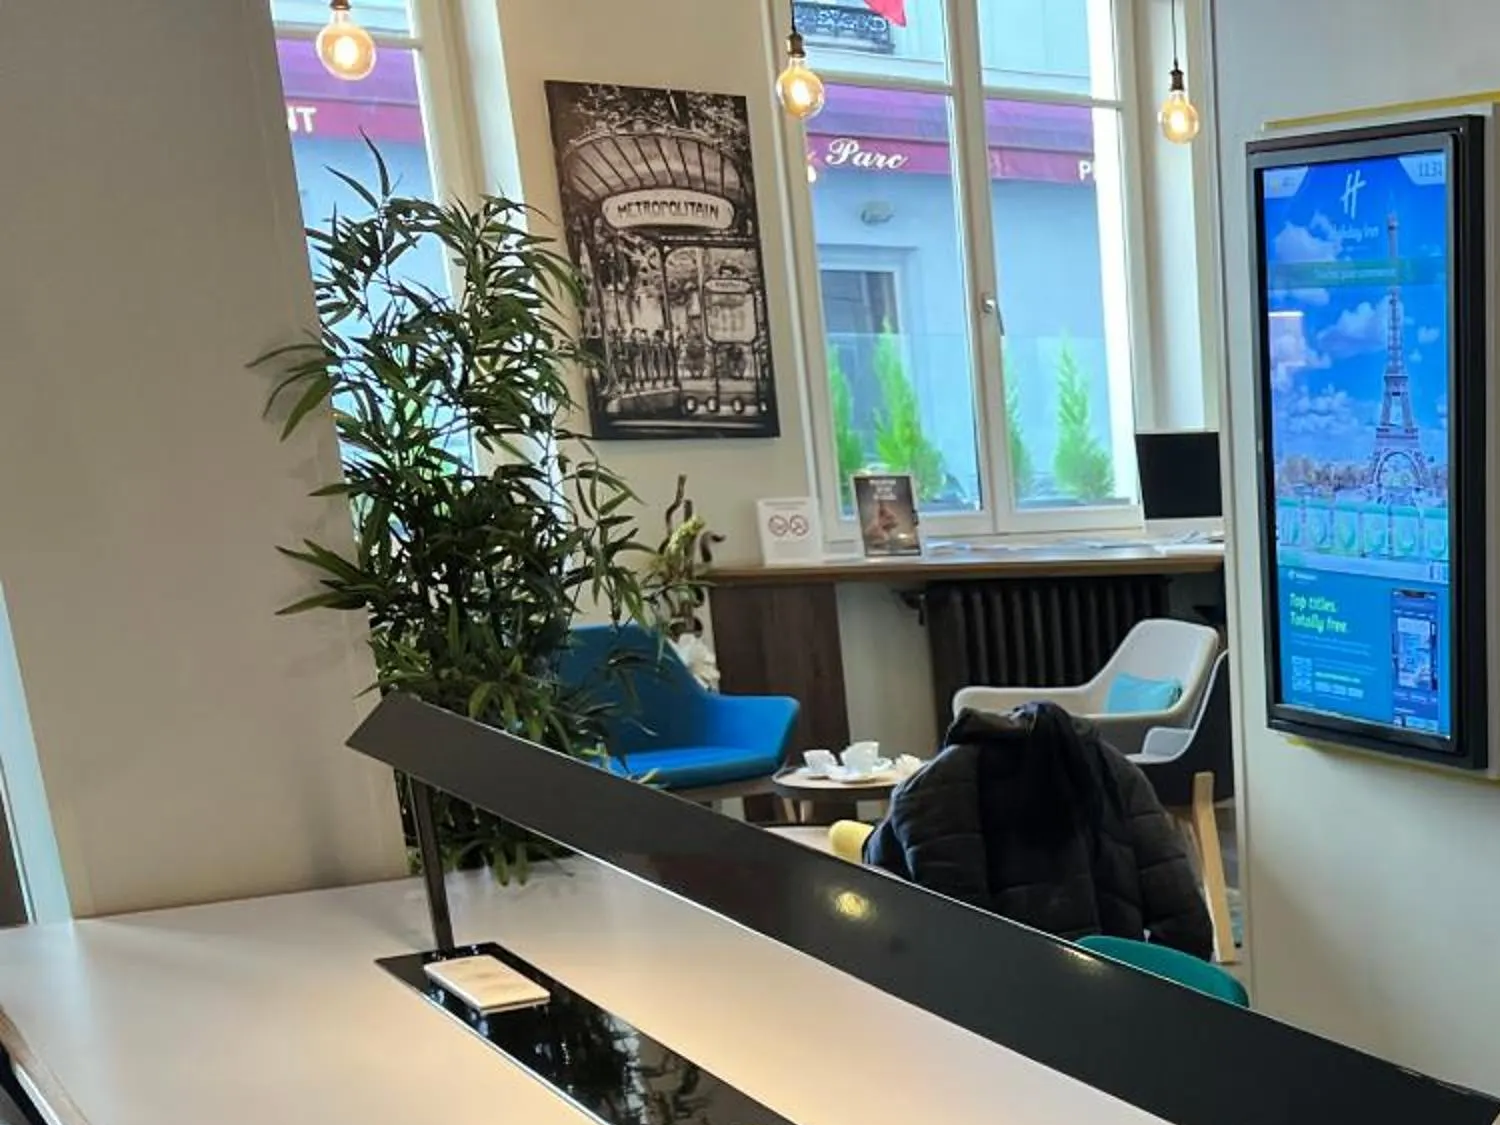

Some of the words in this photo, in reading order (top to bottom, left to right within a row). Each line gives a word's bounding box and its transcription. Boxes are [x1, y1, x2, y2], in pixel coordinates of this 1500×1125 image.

[825, 138, 909, 169] Parc
[617, 200, 719, 221] METROPOLITAIN
[1290, 611, 1325, 634] Totally
